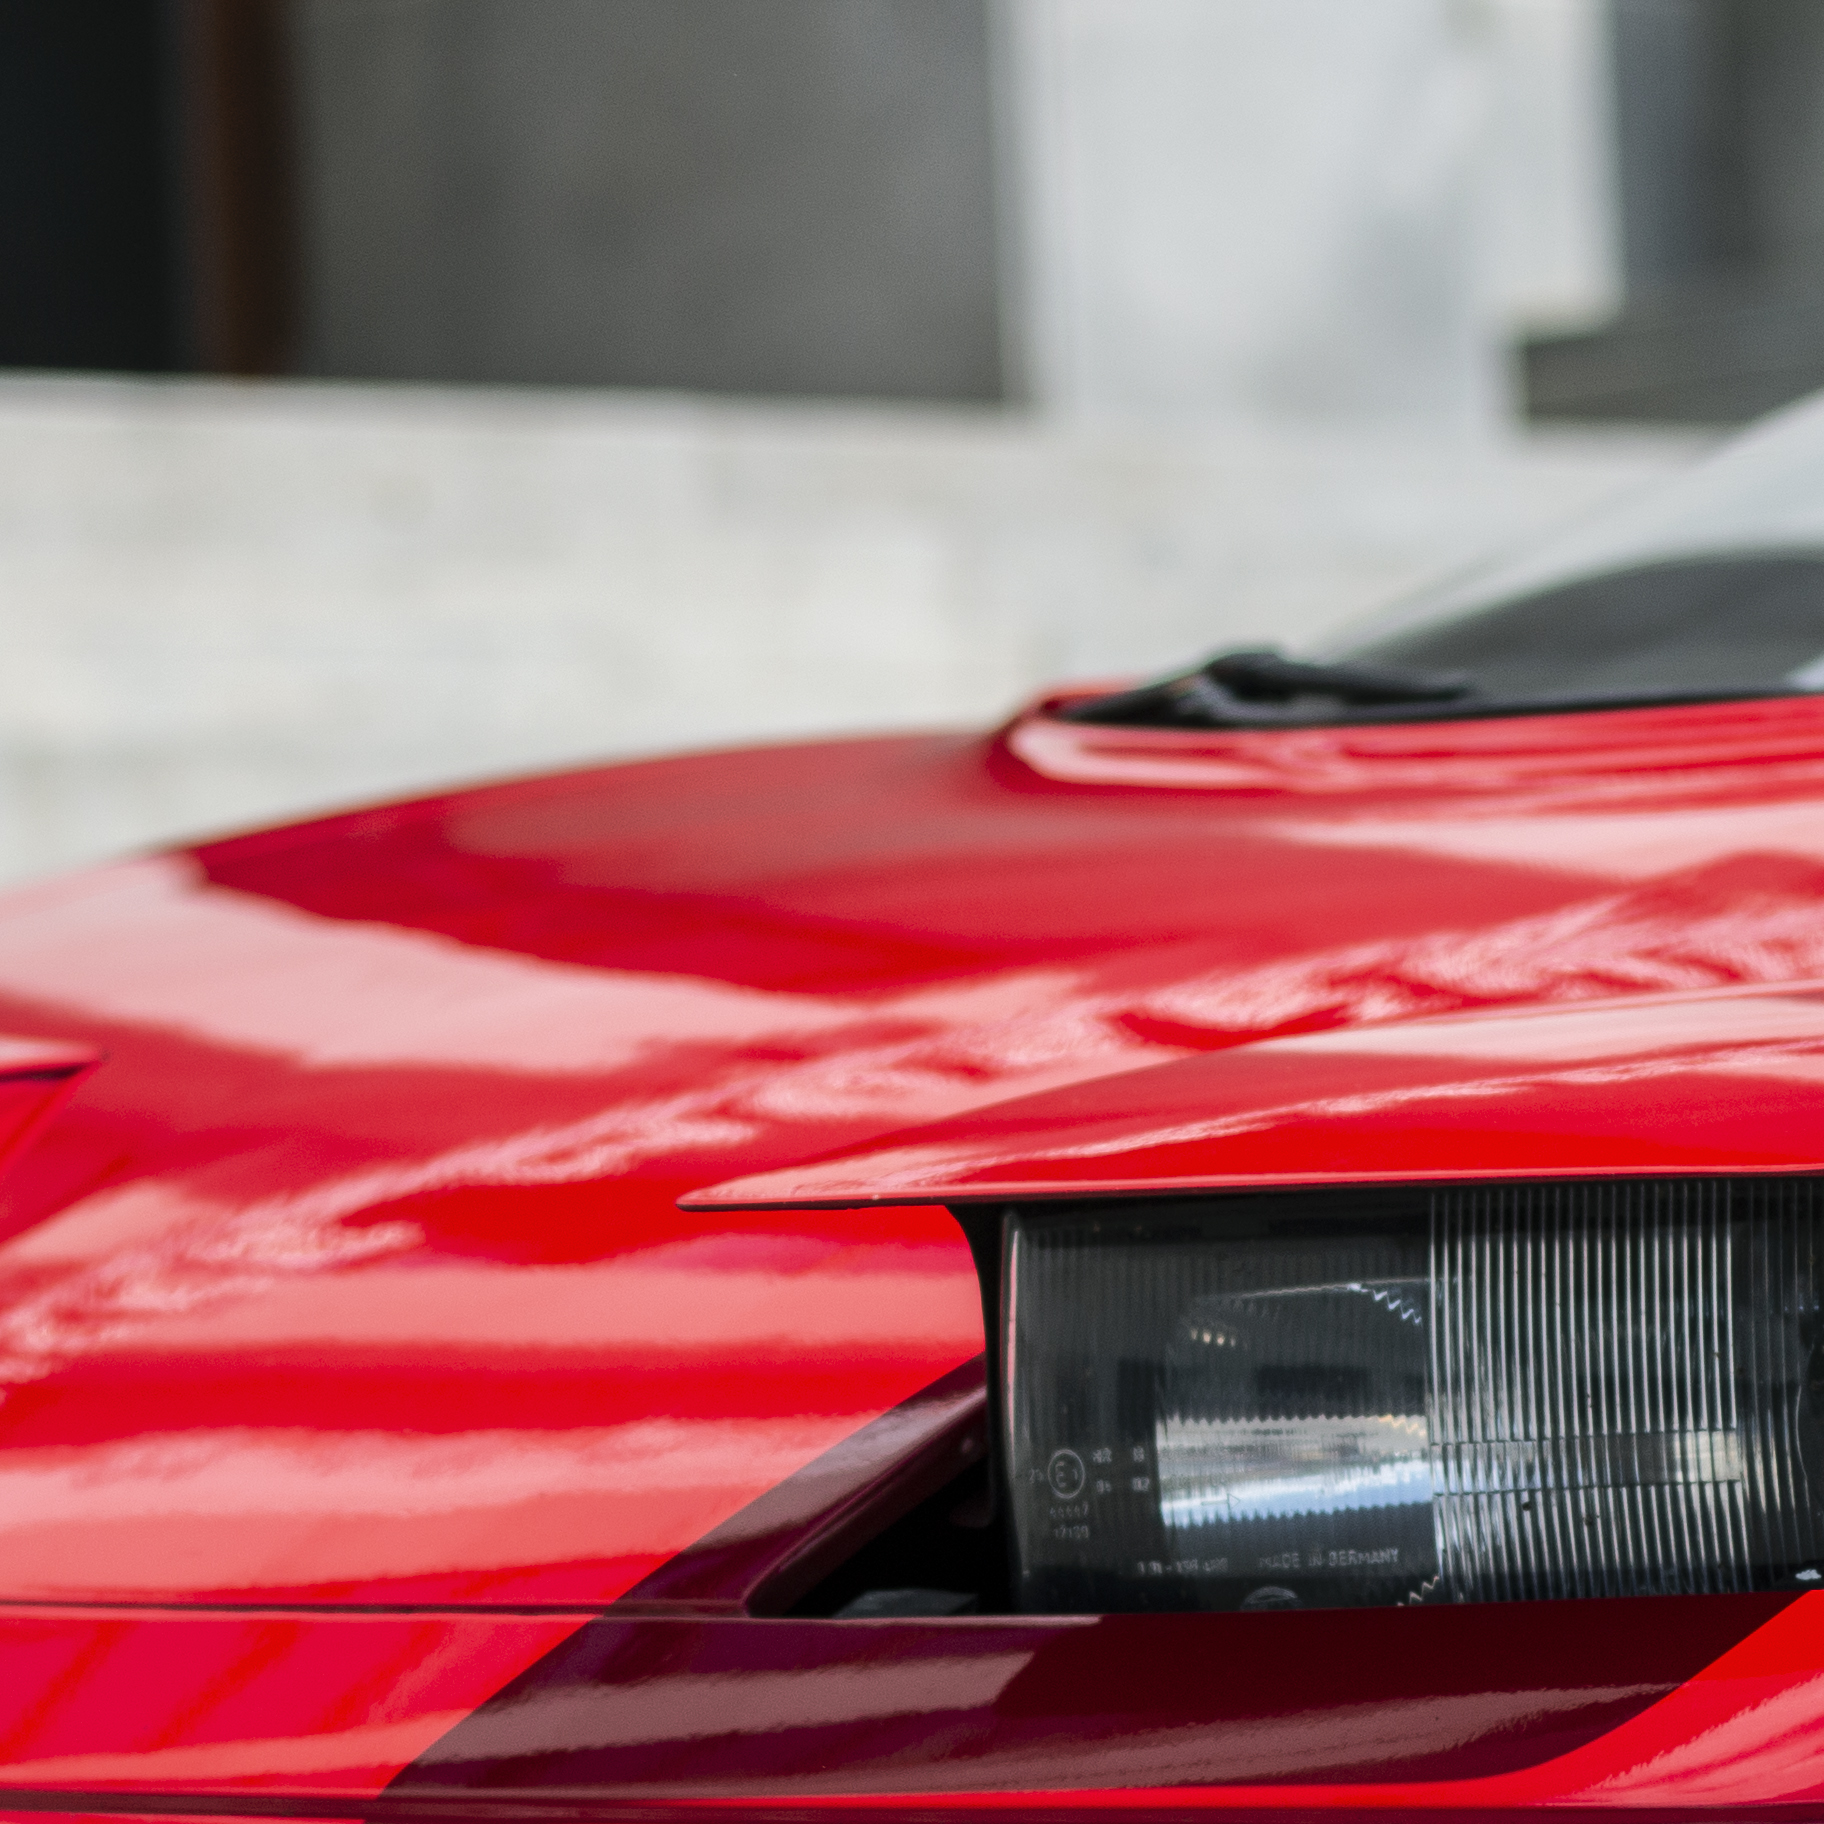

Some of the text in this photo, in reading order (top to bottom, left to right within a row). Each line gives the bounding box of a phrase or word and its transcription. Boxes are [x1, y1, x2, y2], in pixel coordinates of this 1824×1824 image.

[1258, 1547, 1400, 1570] MADE IN GERMANY
